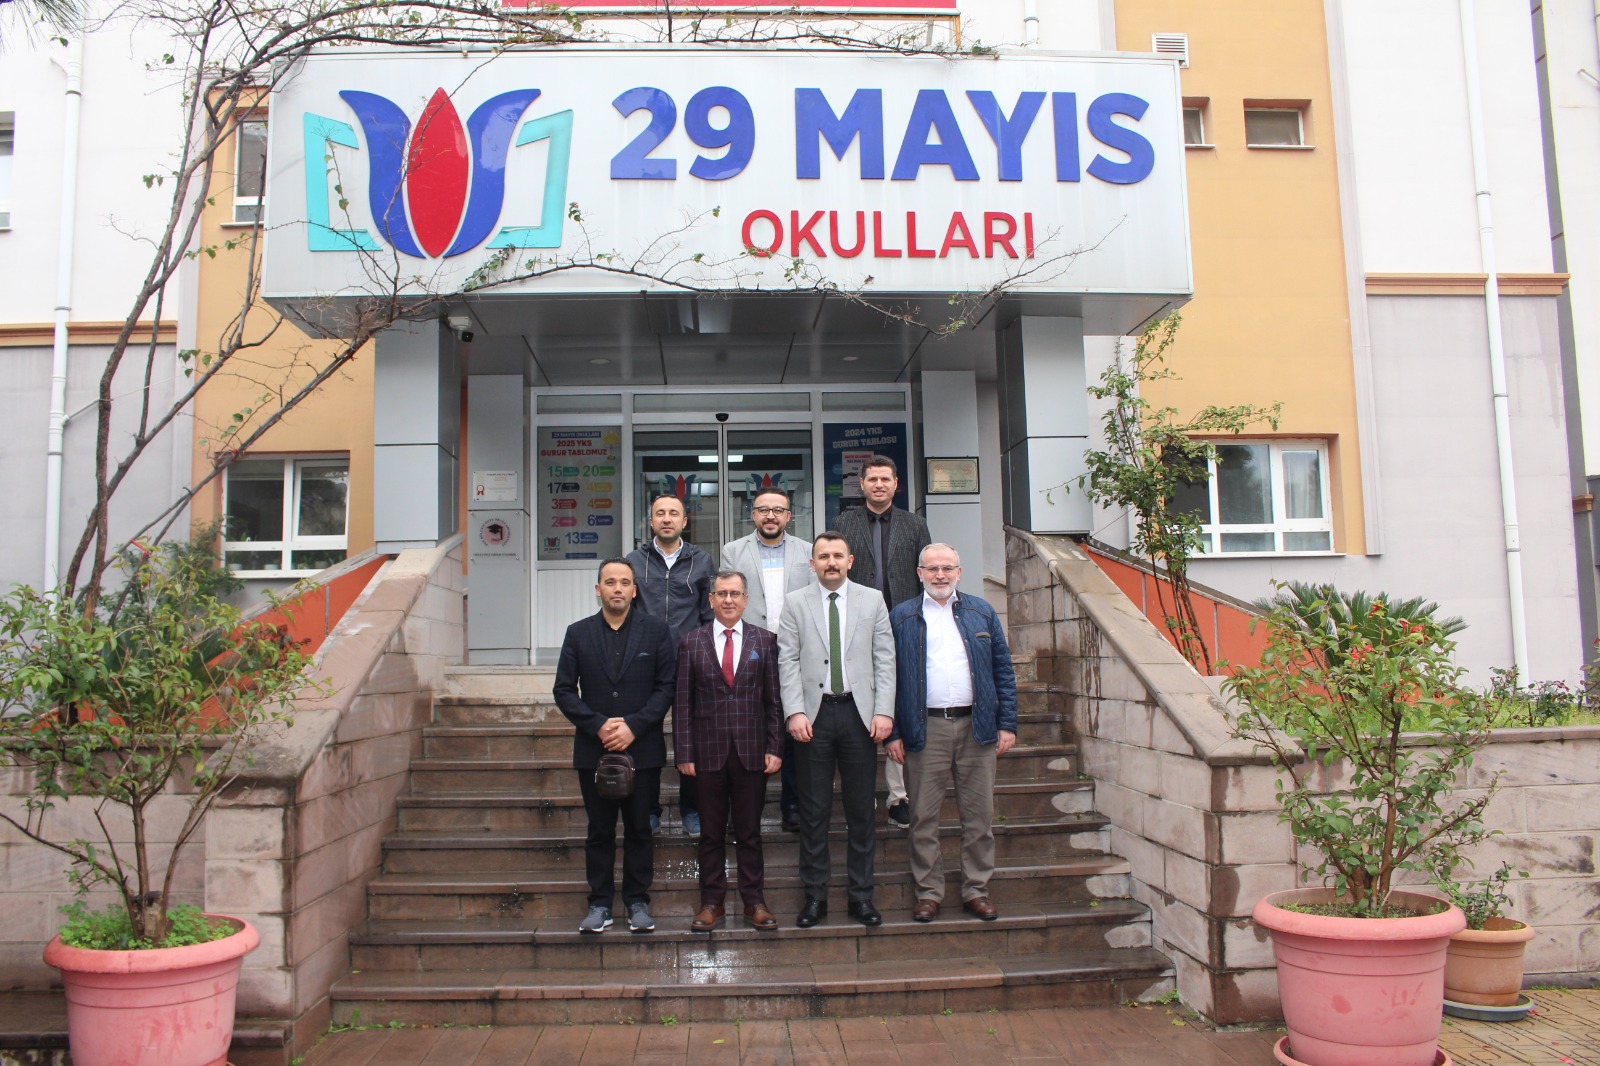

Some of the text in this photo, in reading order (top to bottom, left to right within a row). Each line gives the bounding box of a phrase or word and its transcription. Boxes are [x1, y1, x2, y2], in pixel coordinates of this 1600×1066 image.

[610, 85, 1155, 185] 29 MAYIS
[741, 209, 1035, 259] OKULLARI
[845, 427, 882, 437] 2024 YKS
[833, 436, 897, 449] GURUR TABLOSU
[547, 466, 563, 478] 15
[583, 465, 600, 477] 20
[547, 482, 563, 494] 17
[551, 498, 559, 510] 3
[587, 498, 596, 509] 4
[551, 516, 560, 528] 2
[587, 514, 596, 527] 6
[565, 531, 581, 545] 13
